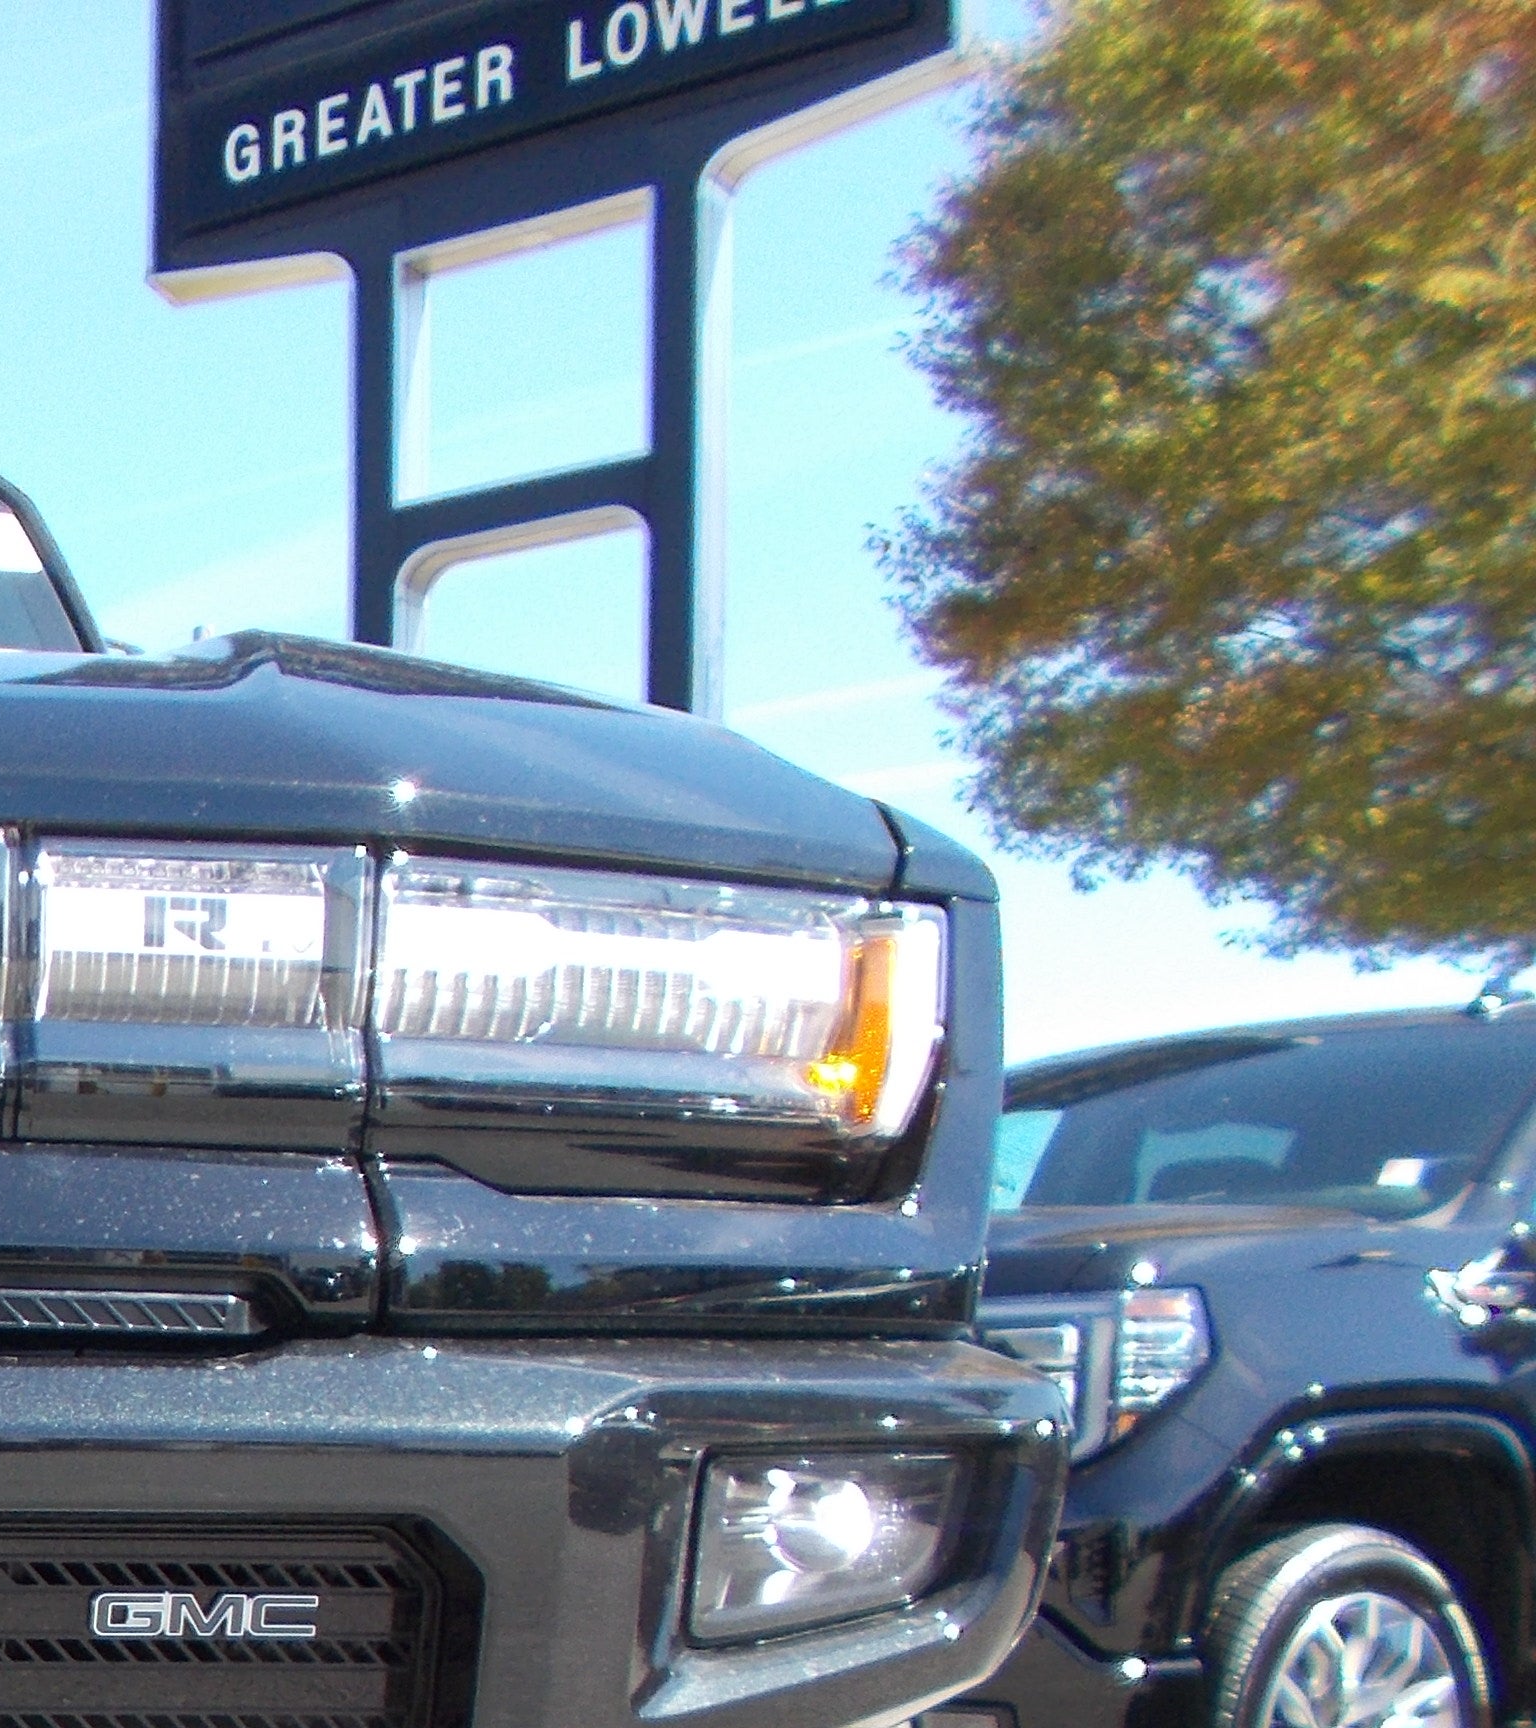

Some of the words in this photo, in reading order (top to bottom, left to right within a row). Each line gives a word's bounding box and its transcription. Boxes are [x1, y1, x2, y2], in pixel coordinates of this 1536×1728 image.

[223, 43, 516, 185] GREATER
[567, 0, 852, 82] LOWE
[92, 1591, 319, 1637] GMC
